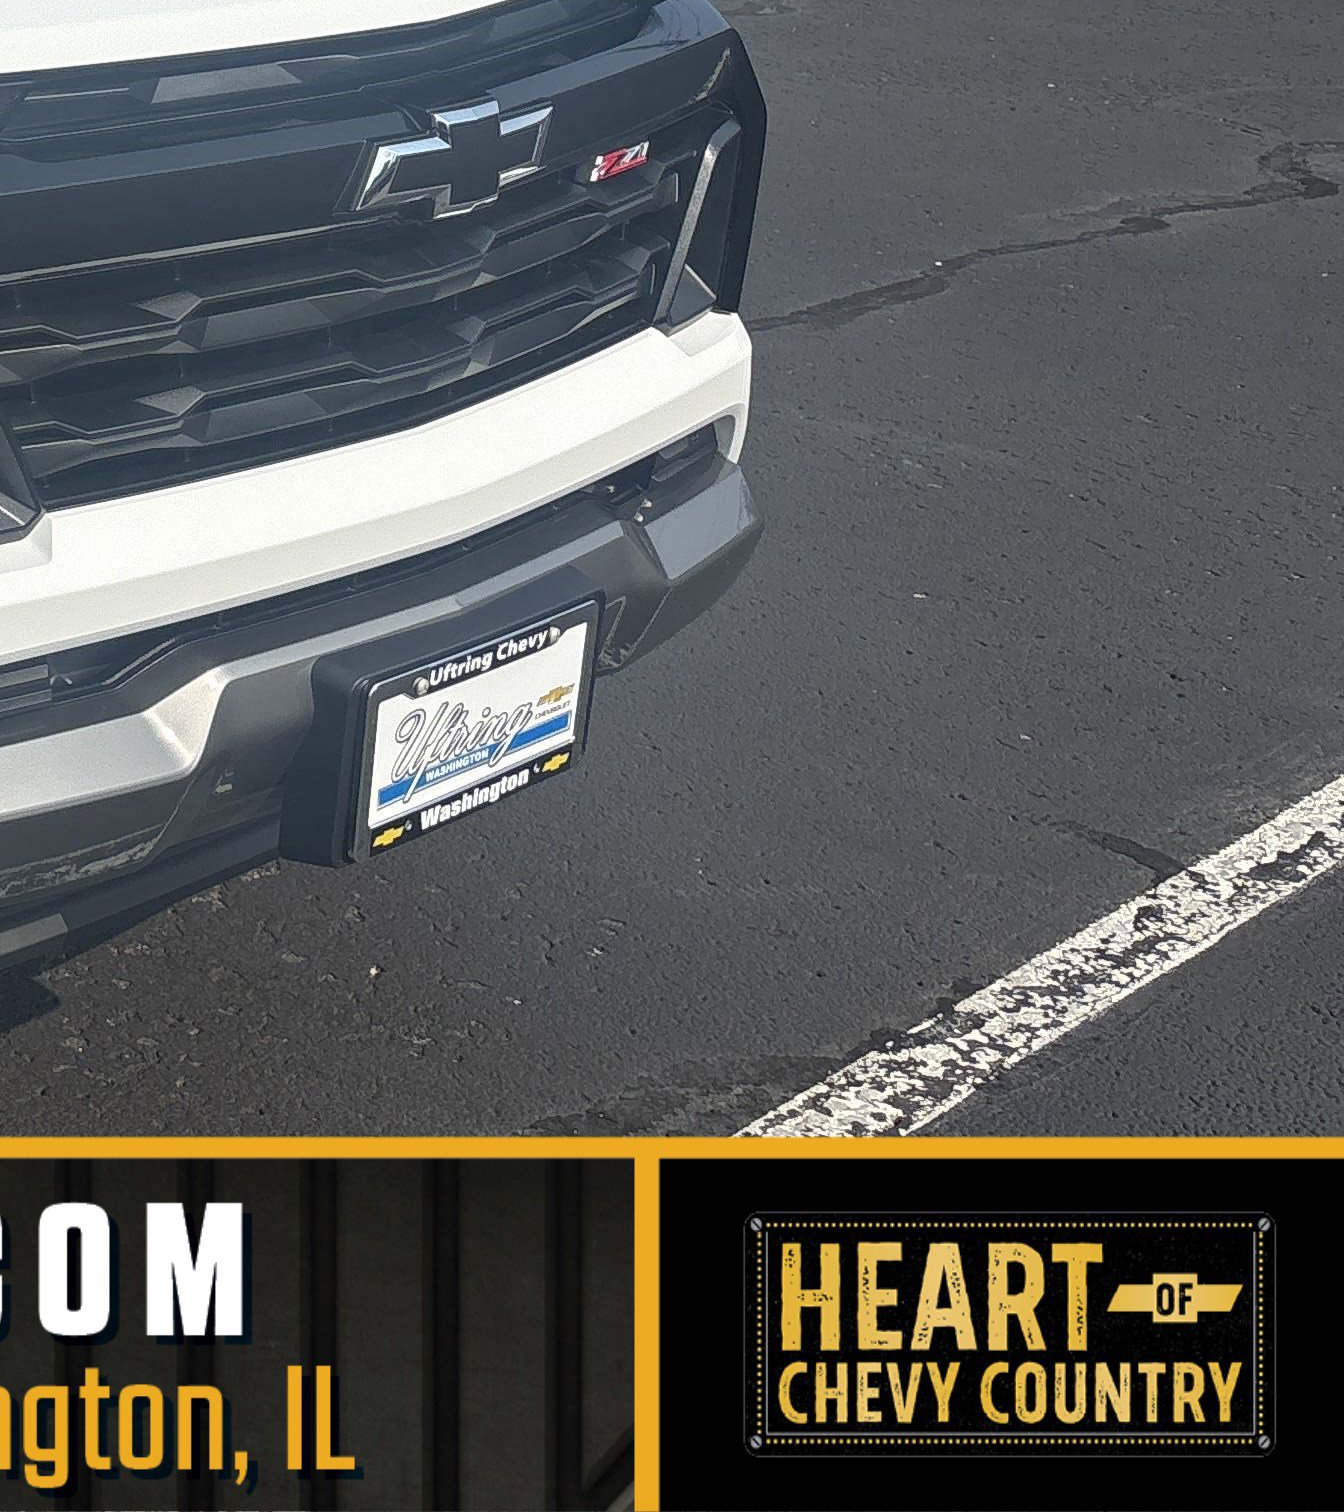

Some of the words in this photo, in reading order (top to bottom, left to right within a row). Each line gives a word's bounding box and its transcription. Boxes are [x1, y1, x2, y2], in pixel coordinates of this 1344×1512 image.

[429, 655, 493, 686] Uftring
[496, 629, 548, 661] Chevy
[391, 701, 534, 804] Uftring
[425, 749, 490, 781] WASHINGTON
[420, 767, 530, 830] Washington
